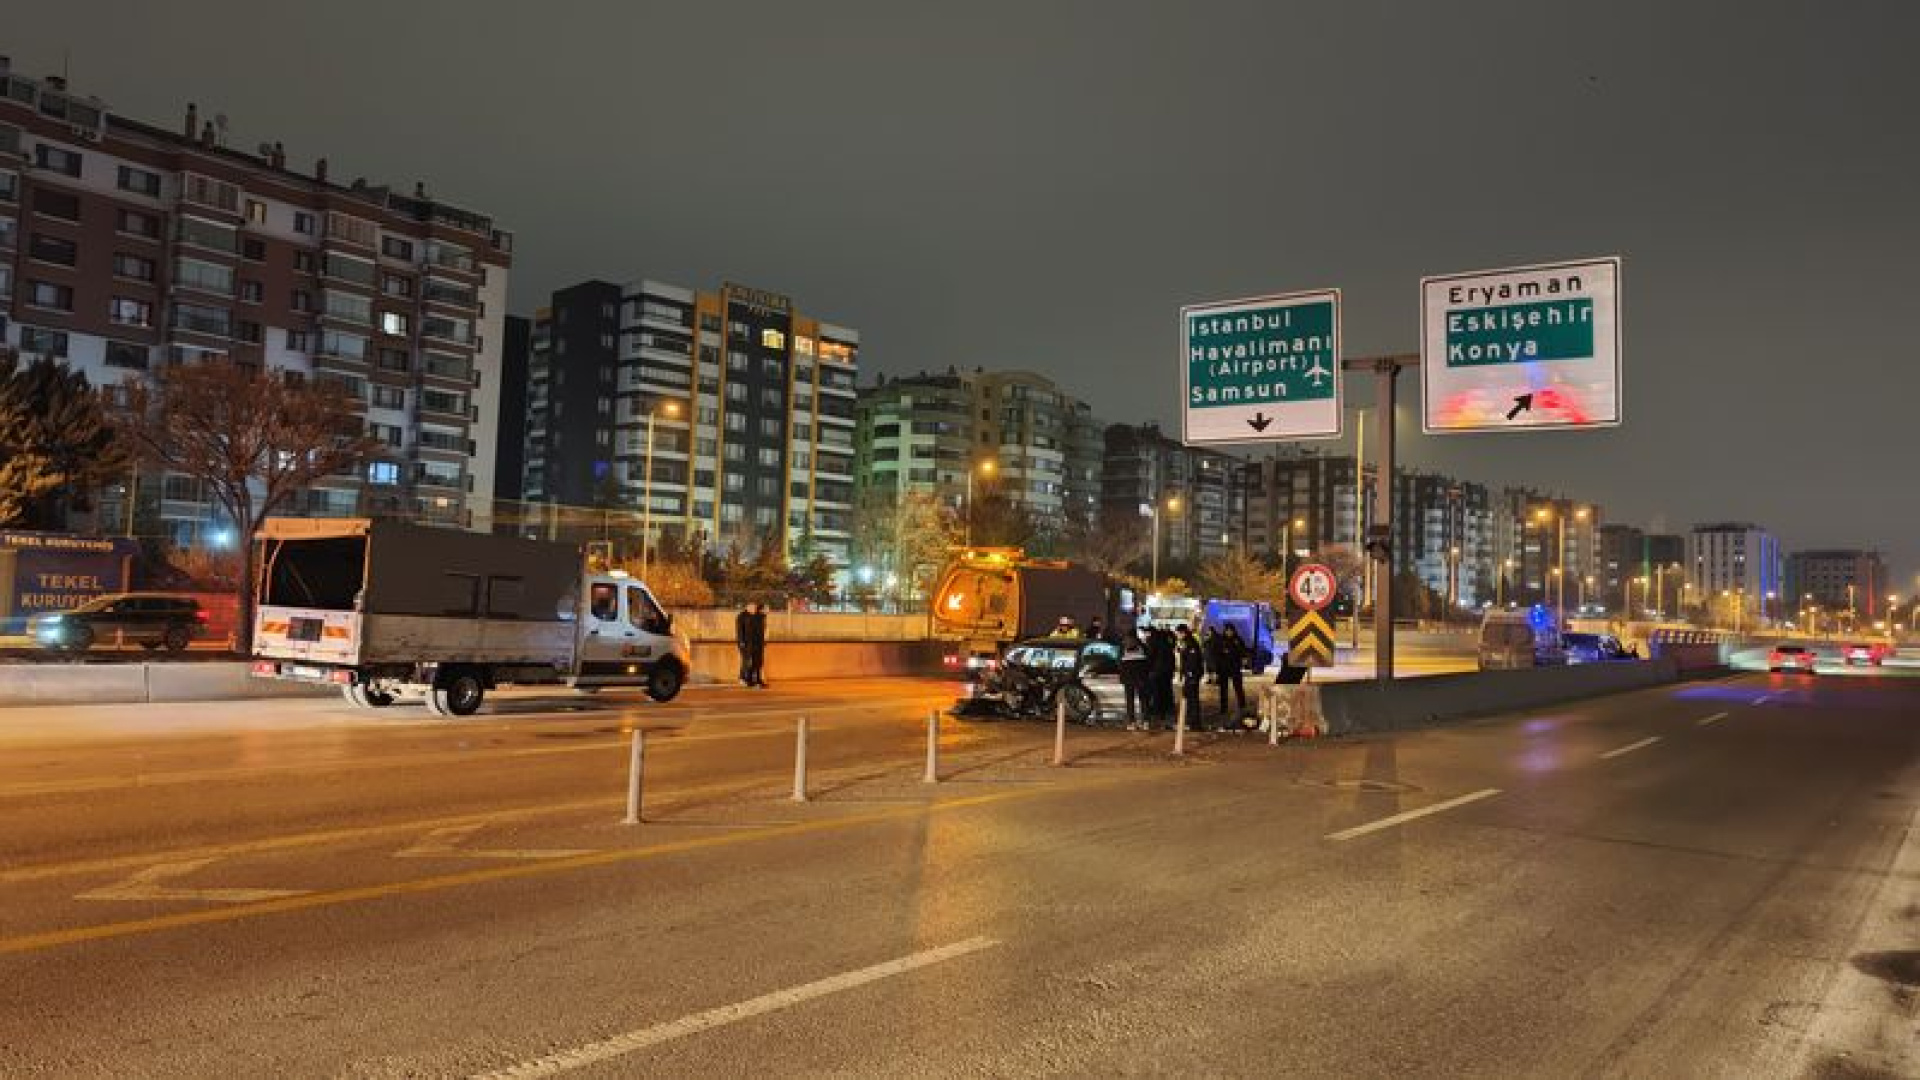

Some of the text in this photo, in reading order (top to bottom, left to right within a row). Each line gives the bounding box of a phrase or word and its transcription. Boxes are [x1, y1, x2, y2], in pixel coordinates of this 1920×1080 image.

[1449, 276, 1582, 305] Eryaman
[1449, 304, 1592, 331] Eskişehir
[1449, 340, 1538, 361] Konya
[1191, 381, 1287, 403] Samsun
[37, 574, 102, 590] TEKEL
